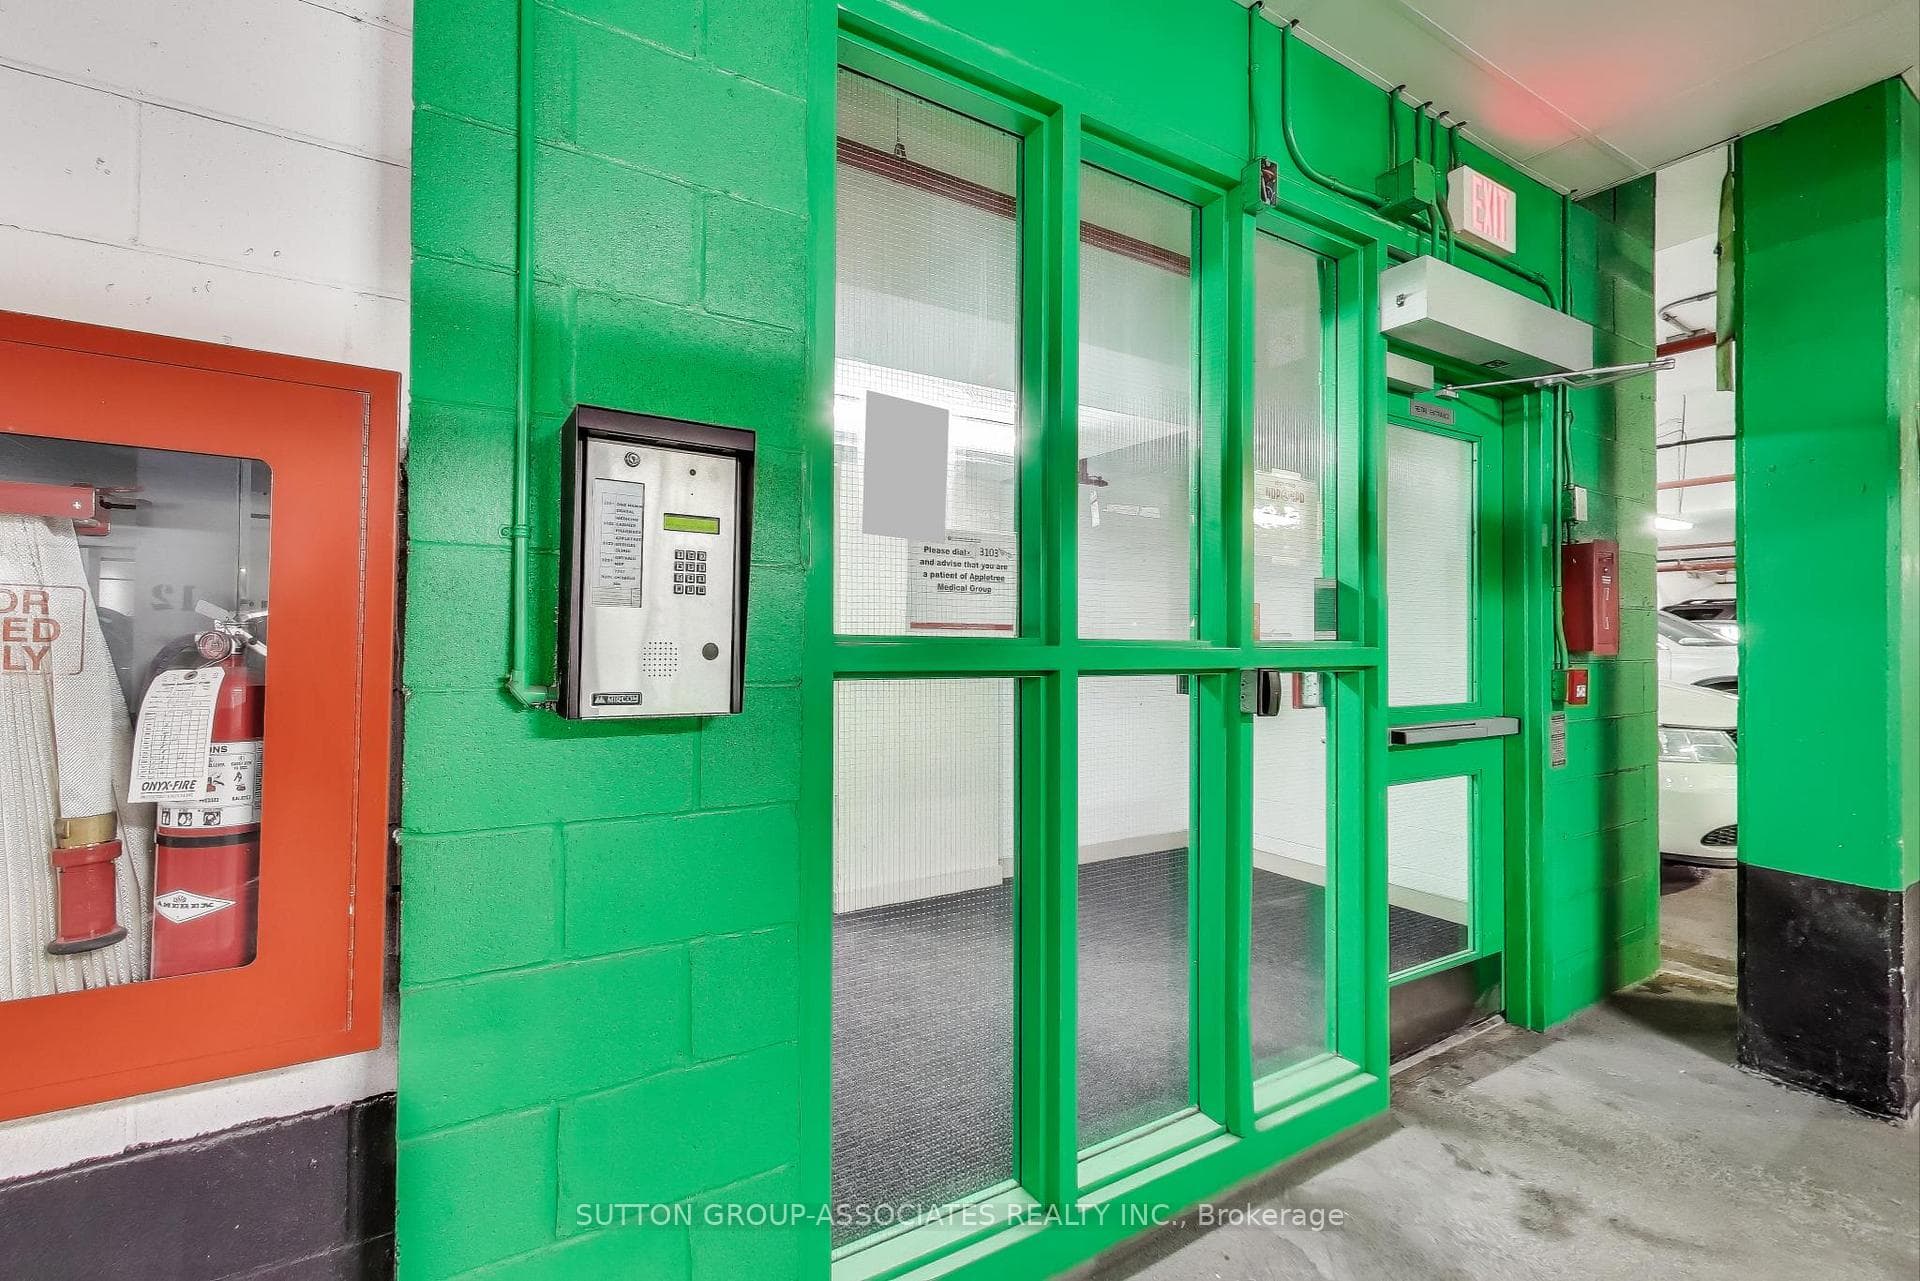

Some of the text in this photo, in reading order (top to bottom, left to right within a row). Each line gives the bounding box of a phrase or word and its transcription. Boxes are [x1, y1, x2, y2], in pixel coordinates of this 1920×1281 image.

[1471, 175, 1509, 242] EXIT
[923, 545, 951, 555] Please
[980, 547, 999, 557] 3103
[919, 558, 935, 566] and
[936, 559, 962, 568] advise
[981, 563, 994, 571] you
[930, 571, 958, 579] patient
[970, 573, 1005, 583] Appletree
[937, 582, 992, 593] Medical Group
[3, 617, 61, 642] ED
[3, 645, 52, 670] LY
